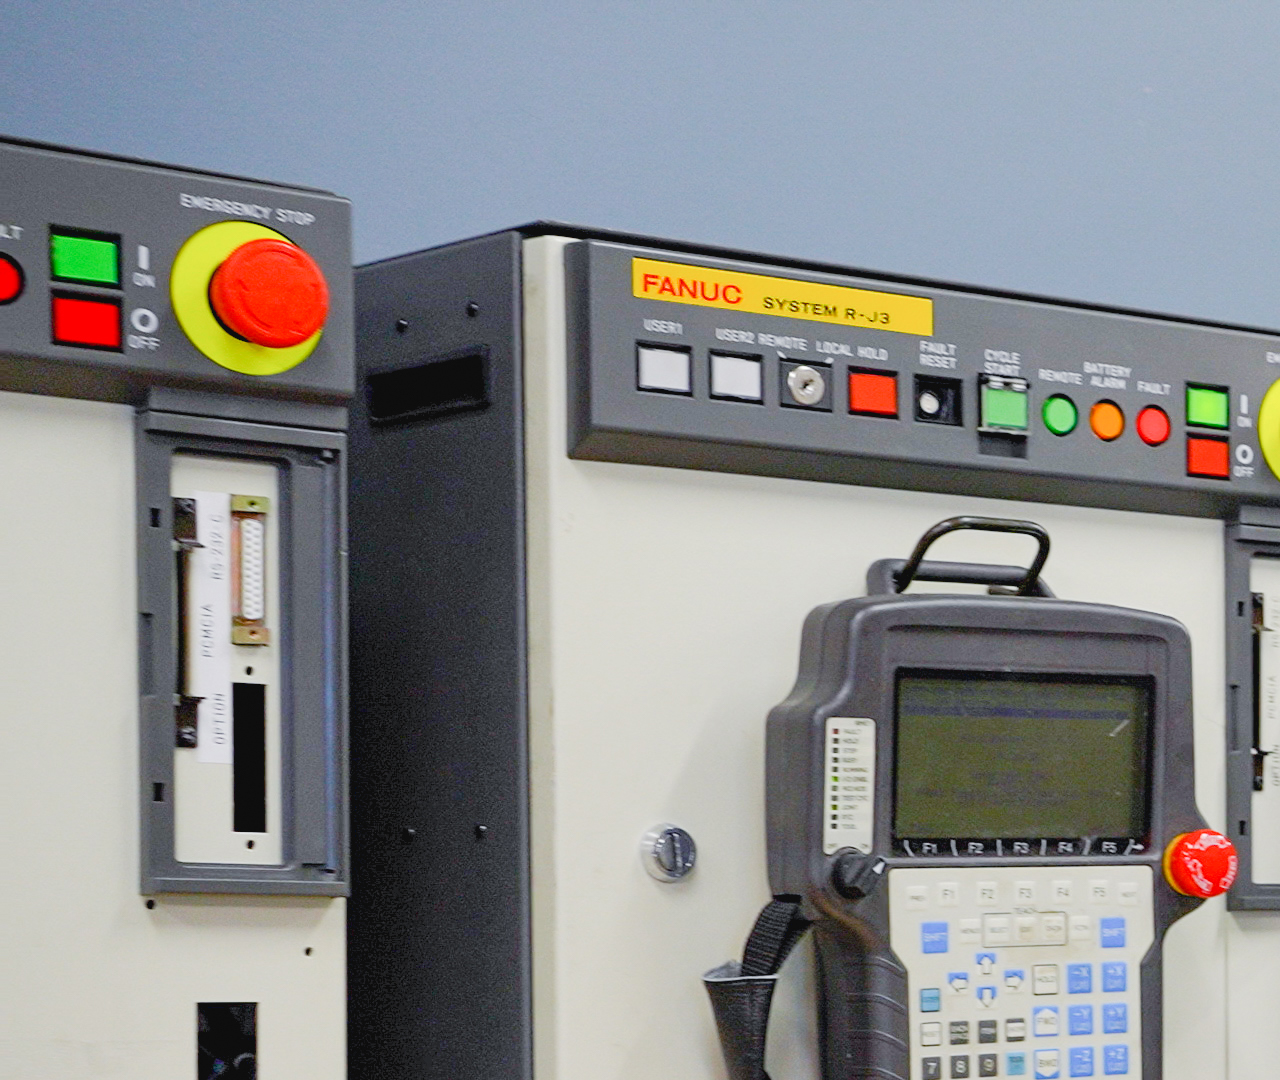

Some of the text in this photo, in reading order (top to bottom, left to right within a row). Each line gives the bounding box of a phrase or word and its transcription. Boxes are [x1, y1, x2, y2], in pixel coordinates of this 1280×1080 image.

[180, 193, 316, 225] EMERGENCY STOP
[643, 273, 890, 324] FANUC SYSTEM R-J3
[643, 319, 683, 336] USER1
[127, 334, 160, 350] OFF
[715, 328, 754, 345] USER2
[758, 330, 807, 351] REMOTE
[816, 340, 853, 357] LOCAL
[857, 346, 888, 361] HOLD
[919, 340, 956, 356] FAULT
[919, 354, 956, 370] RESET
[984, 349, 1021, 364] CYCLE
[984, 362, 1020, 377] START
[1083, 361, 1132, 378] BATTERY
[1038, 369, 1083, 386] REMOTE
[1090, 376, 1126, 390] ALARM
[1137, 381, 1171, 395] FAULT
[1233, 465, 1254, 477] OFF
[201, 603, 215, 657] PCMCIA
[213, 693, 227, 745] OPTION
[1271, 744, 1280, 787] OPTION
[922, 842, 937, 854] F1
[967, 842, 984, 854] F2
[1013, 842, 1030, 854] F3
[1058, 841, 1074, 853] F4
[1102, 841, 1118, 854] F5
[942, 888, 955, 900] F1
[981, 888, 995, 900] F2
[1019, 887, 1032, 899] F3
[1057, 886, 1071, 897] F4
[1093, 886, 1106, 898] F5
[955, 1060, 966, 1073] 8
[983, 1058, 994, 1072] 9
